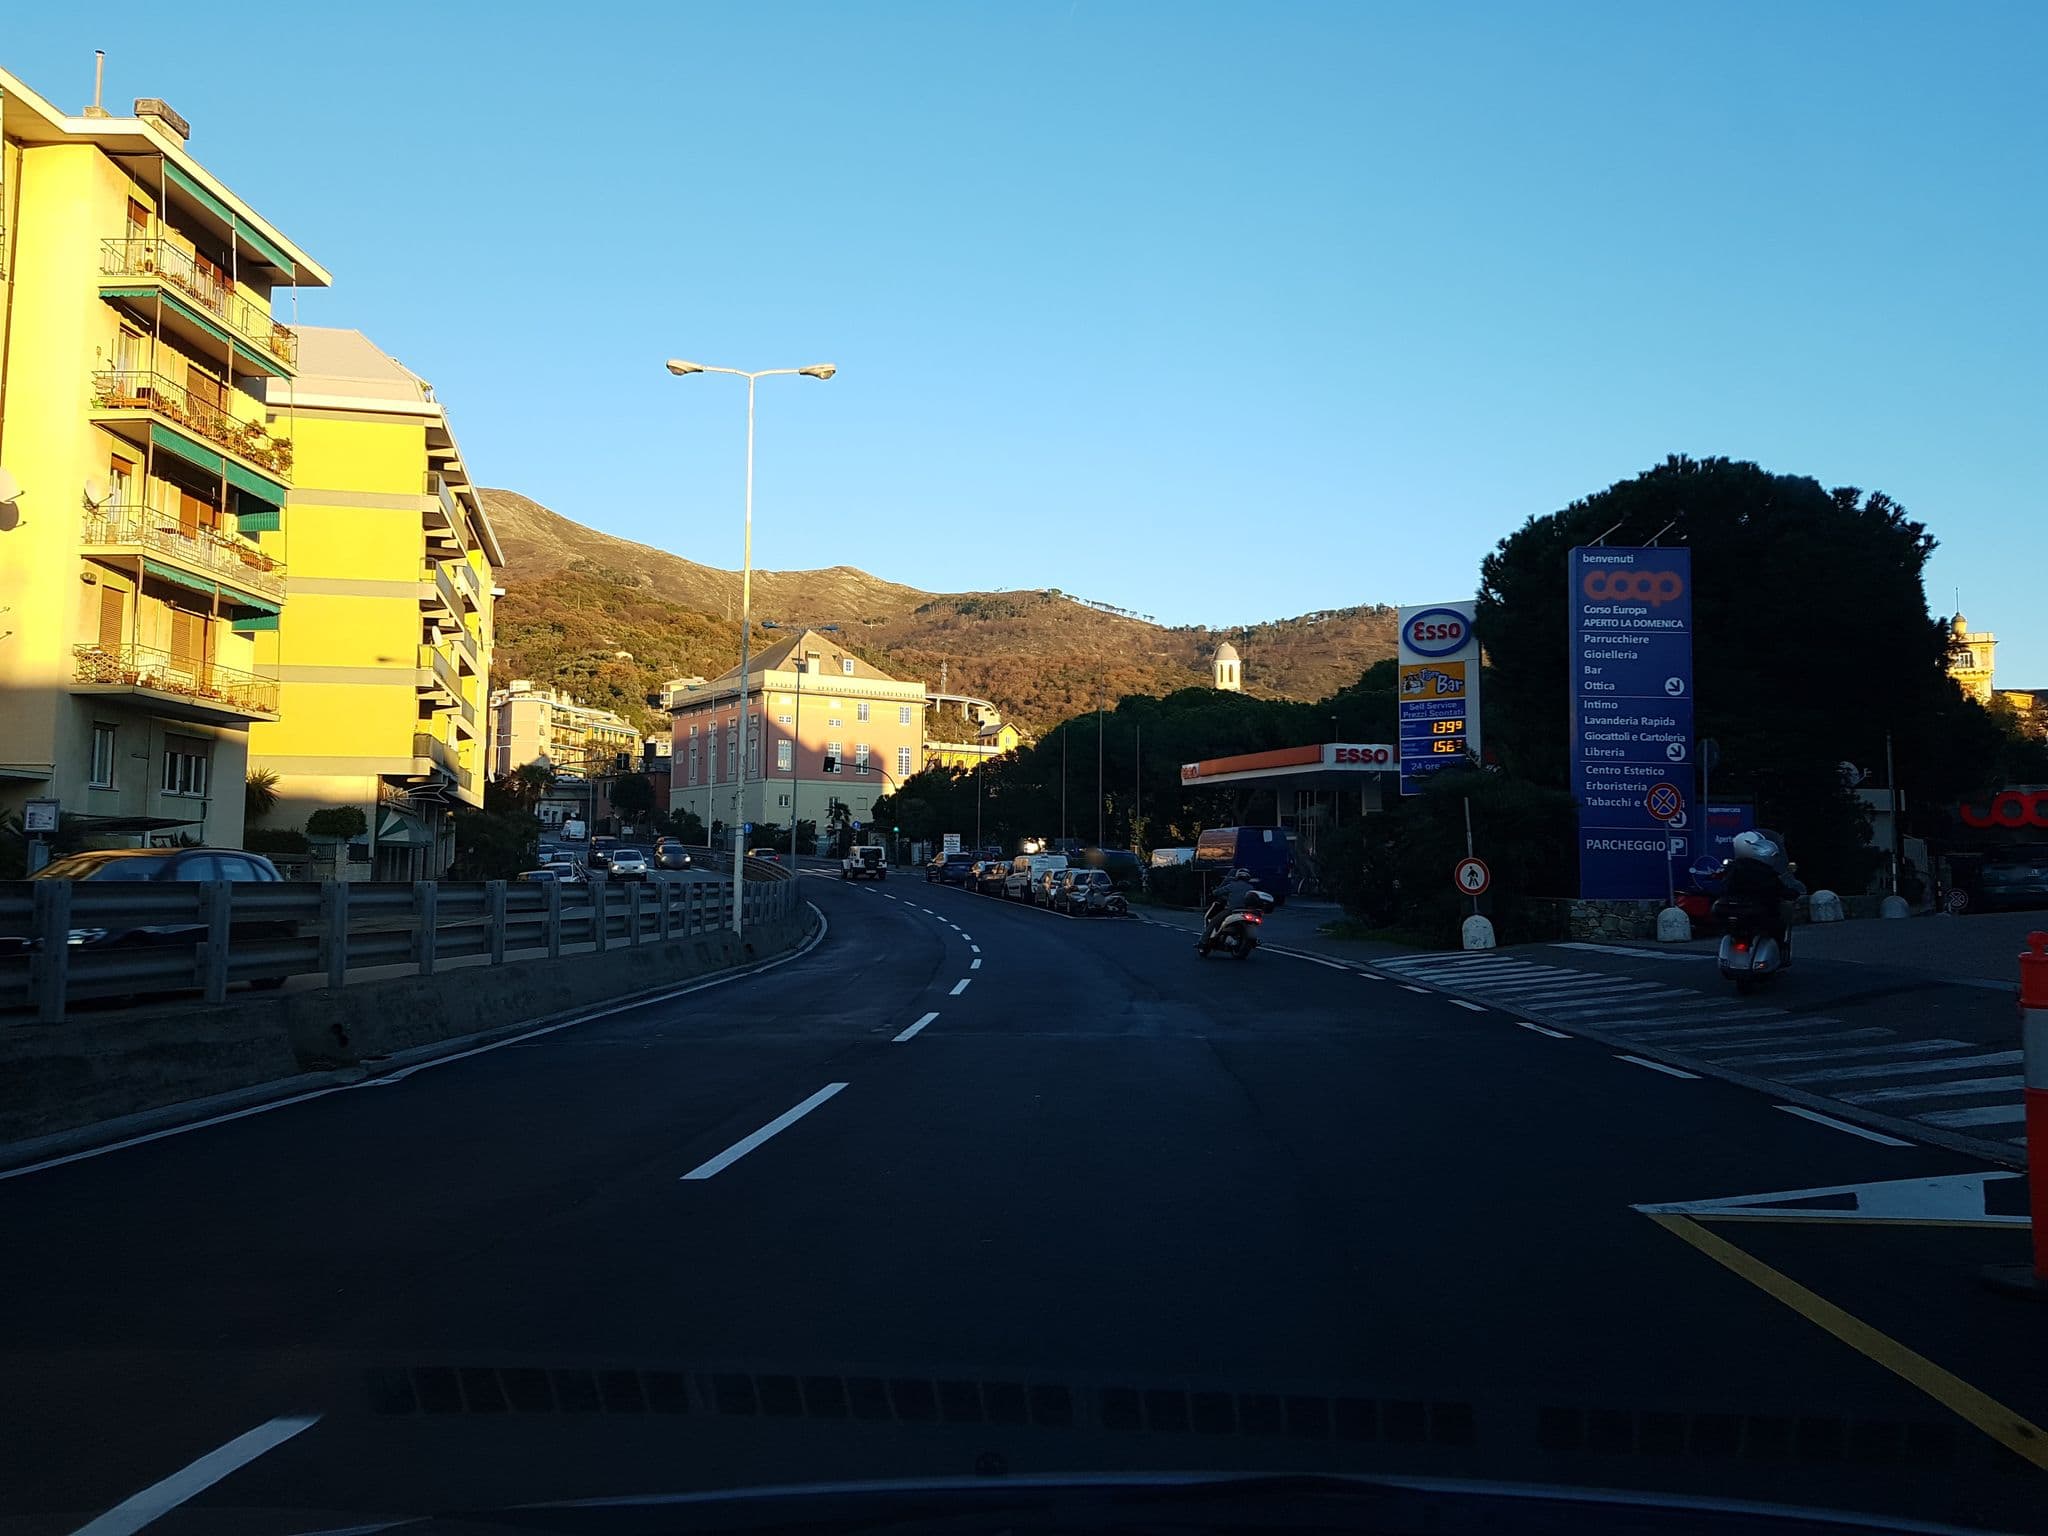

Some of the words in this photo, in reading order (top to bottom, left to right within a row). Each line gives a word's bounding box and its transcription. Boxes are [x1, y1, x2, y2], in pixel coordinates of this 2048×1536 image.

[1583, 554, 1634, 563] benvenuti
[1583, 570, 1683, 608] coop
[1584, 605, 1611, 614] Corso
[1613, 605, 1647, 616] Europa
[1584, 619, 1619, 627] APERTO
[1620, 619, 1632, 627] LA
[1634, 620, 1684, 628] DOMENICA
[1584, 635, 1649, 644] Parrucchiere
[1584, 650, 1638, 659] Gioielleria
[1584, 666, 1602, 674] Bar
[1436, 675, 1463, 693] Bar
[1584, 681, 1615, 690] Ottica
[1427, 702, 1457, 710] Service
[1584, 700, 1618, 709] Intimo
[1584, 716, 1638, 725] Lavanderia
[1641, 717, 1675, 727] Rapida
[1585, 732, 1630, 741] Giocattoli
[1640, 733, 1686, 742] Cartoleria
[1585, 747, 1625, 757] Libreria
[1586, 766, 1621, 775] Centro
[1624, 766, 1665, 775] Estetico
[1586, 781, 1647, 791] Erboristeria
[1586, 797, 1631, 807] Tabacchi
[1586, 839, 1666, 851] PARCHEGGIO
[1670, 838, 1684, 854] P
